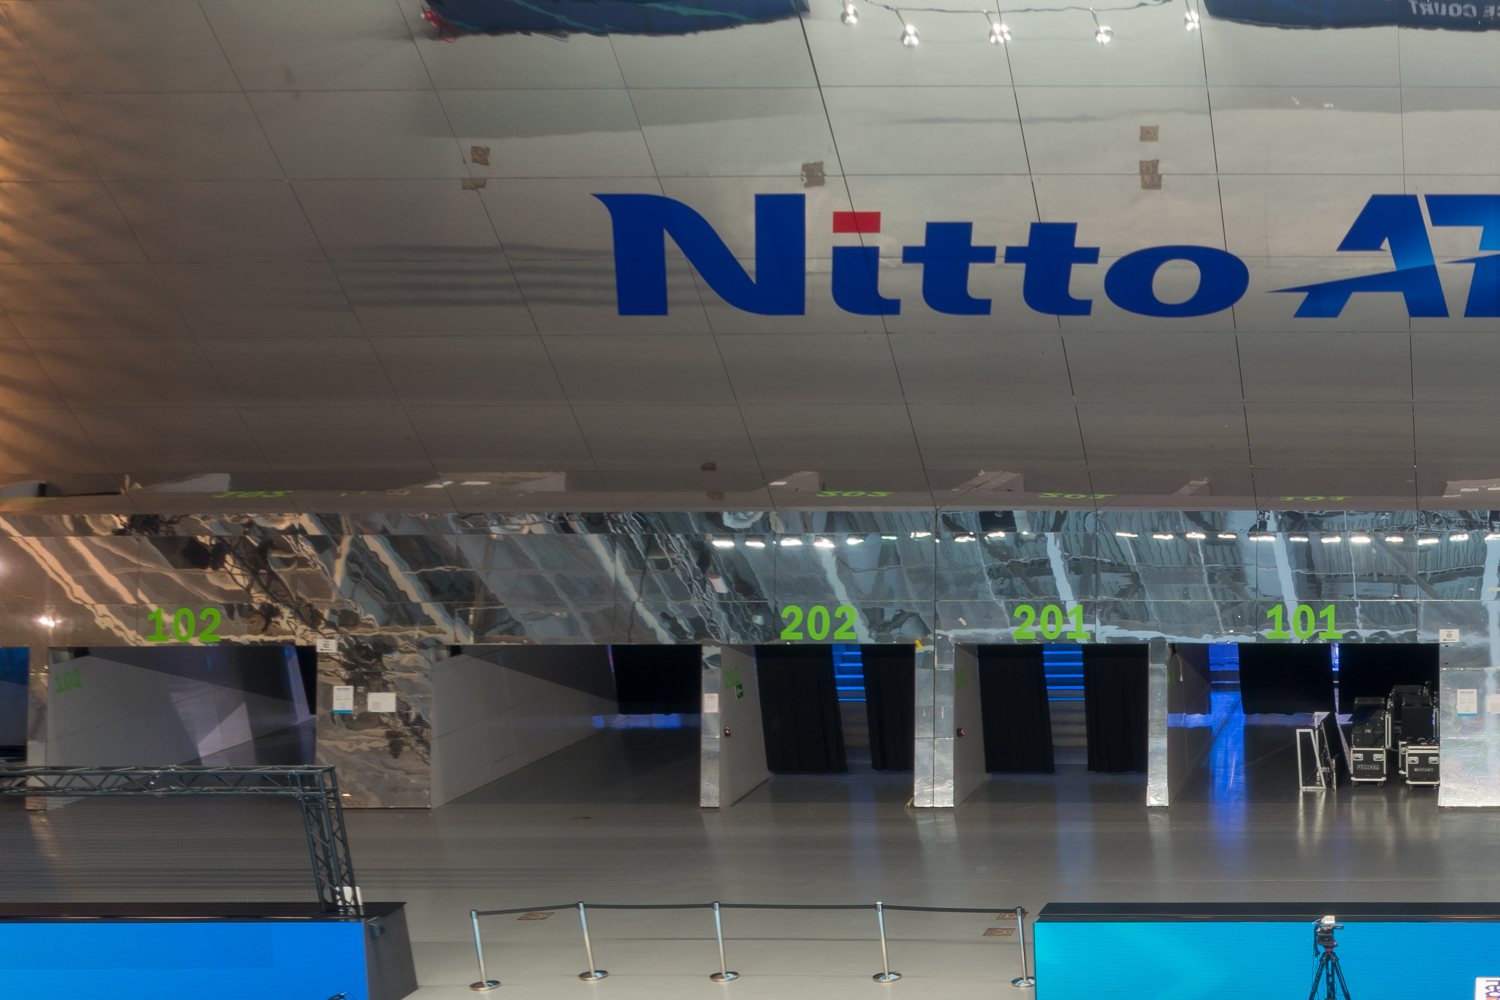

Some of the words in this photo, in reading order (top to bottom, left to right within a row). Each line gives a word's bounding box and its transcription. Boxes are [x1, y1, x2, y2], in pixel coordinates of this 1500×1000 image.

[591, 193, 1250, 318] Nitto
[146, 607, 222, 643] 102
[780, 604, 857, 641] 202
[1013, 604, 1091, 641] 201
[1266, 604, 1343, 640] 101
[54, 669, 83, 694] 102
